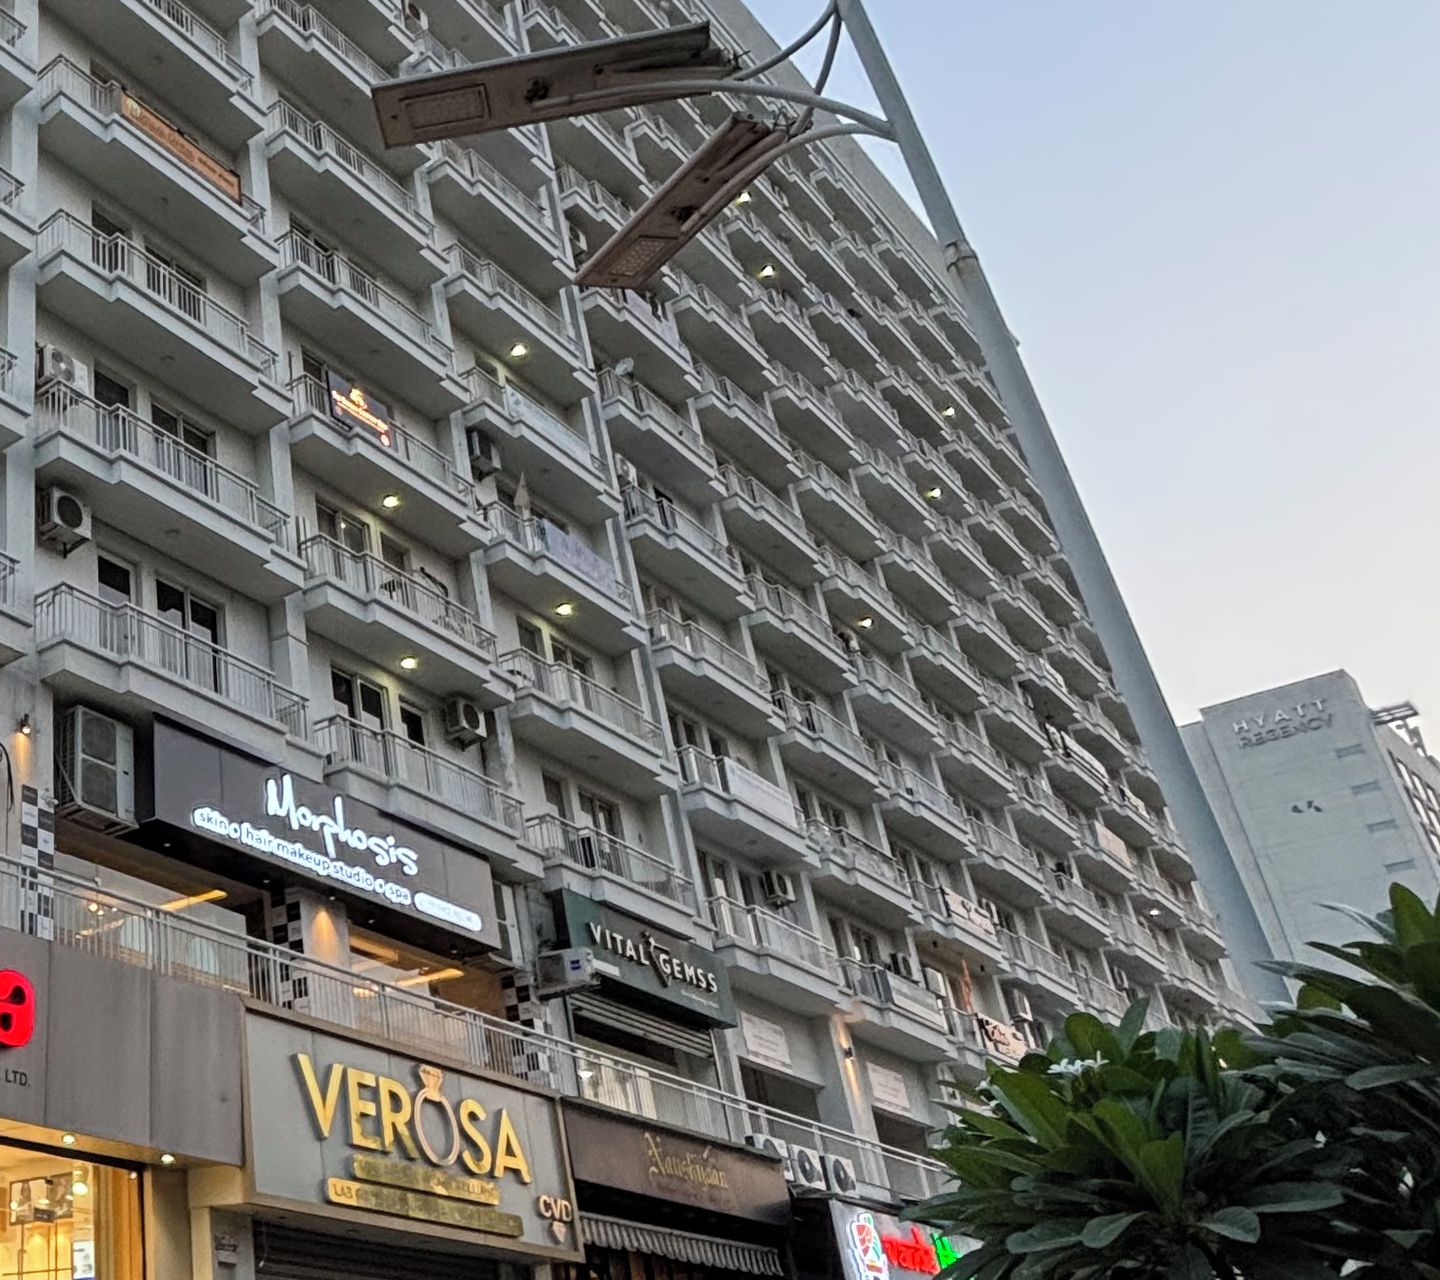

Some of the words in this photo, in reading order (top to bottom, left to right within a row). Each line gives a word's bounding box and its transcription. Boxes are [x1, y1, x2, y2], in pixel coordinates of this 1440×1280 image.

[1232, 698, 1328, 735] HYATT
[1239, 712, 1333, 749] REGENCY
[265, 773, 419, 876] Morphosis
[196, 808, 228, 832] skin
[244, 823, 275, 852] hair
[276, 840, 331, 873] makeup
[332, 860, 375, 890] studio
[387, 883, 410, 905] spa
[589, 921, 650, 966] VITAL
[659, 953, 718, 993] GEMSS
[5, 1069, 31, 1088] LTD.
[295, 1052, 532, 1185] VEROSA
[538, 1194, 572, 1222] CVD
